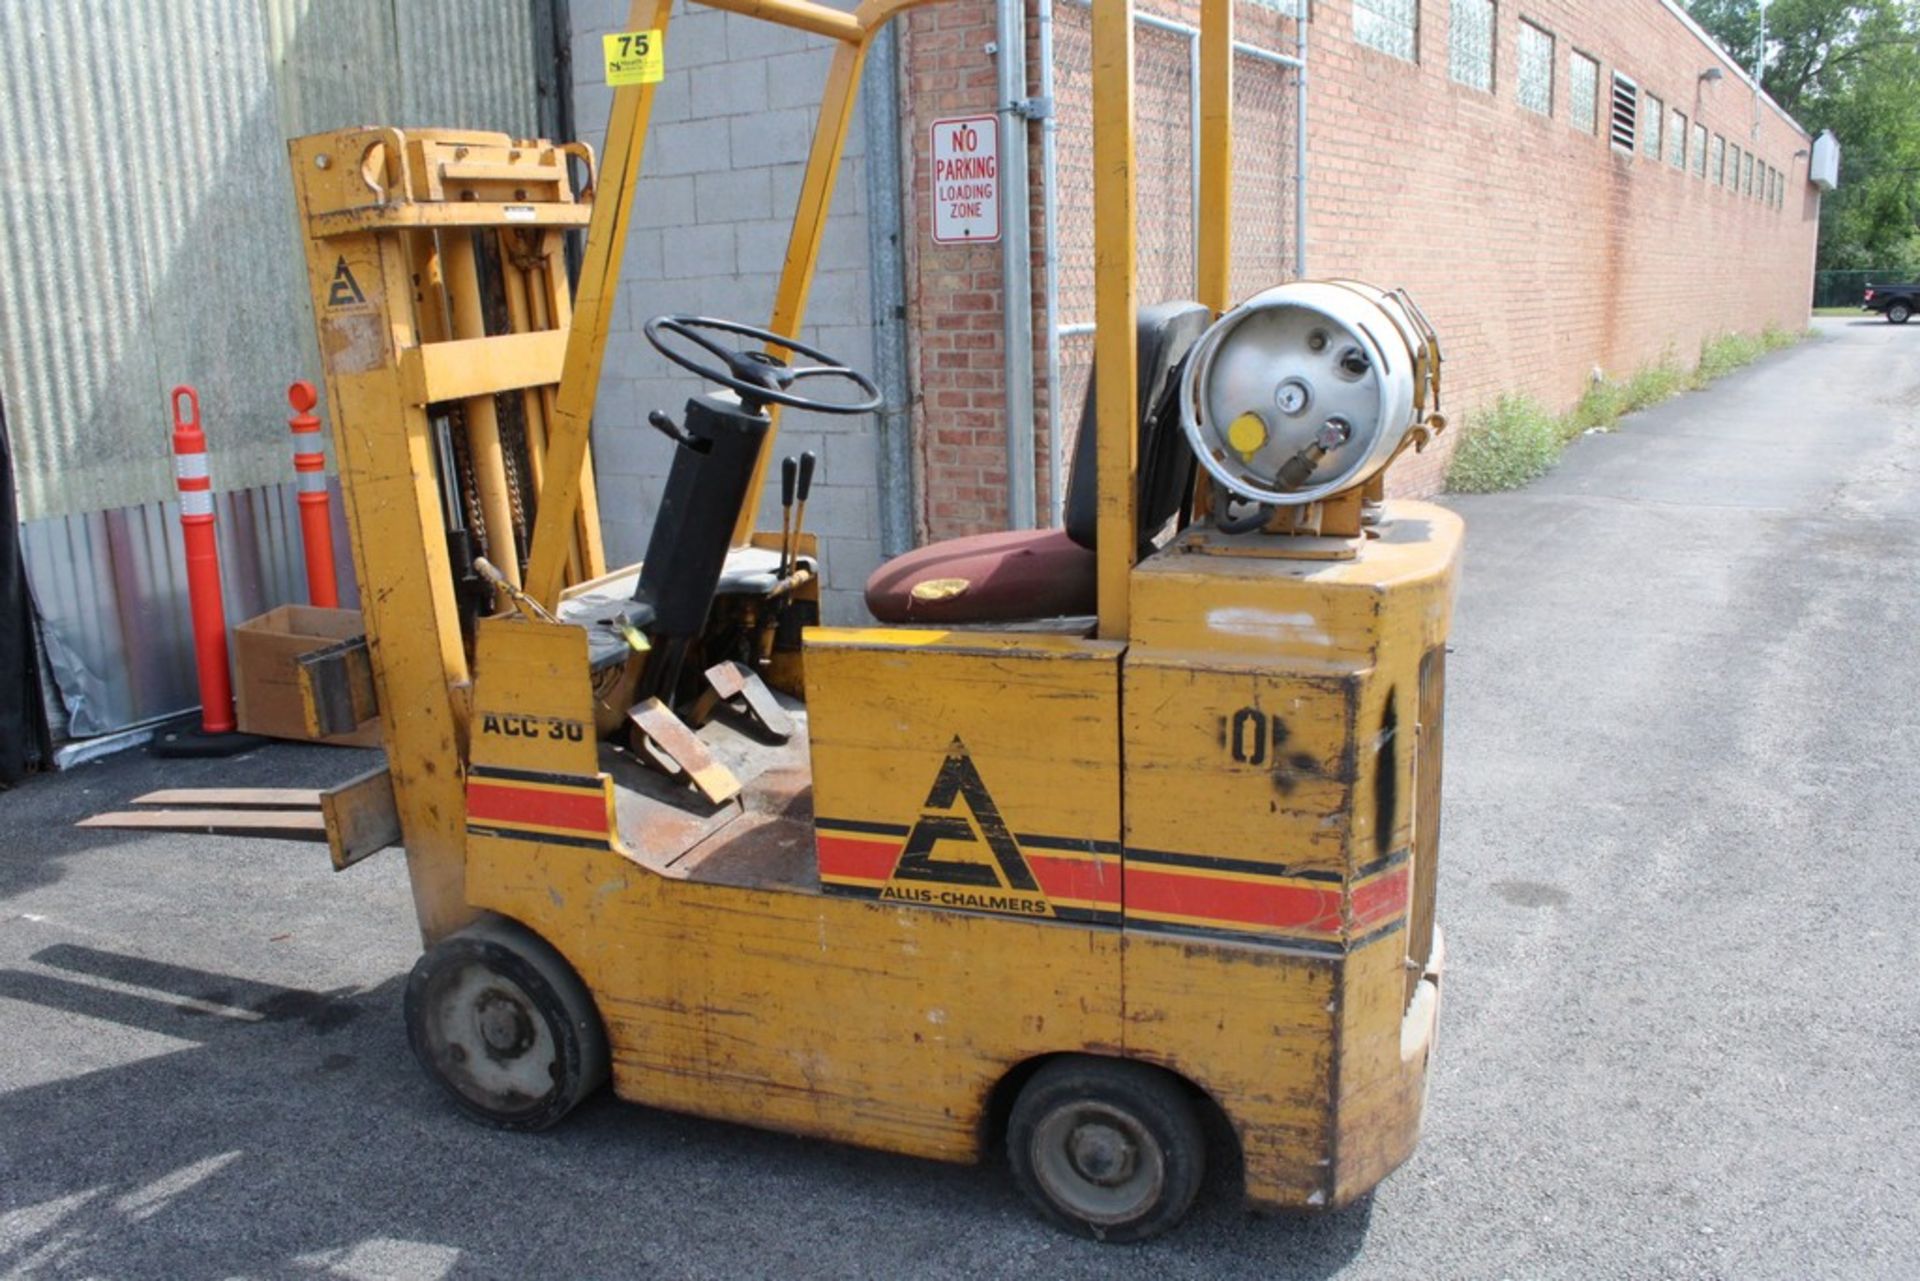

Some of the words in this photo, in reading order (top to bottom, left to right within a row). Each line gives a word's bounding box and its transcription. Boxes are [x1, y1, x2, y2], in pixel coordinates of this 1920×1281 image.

[617, 35, 649, 57] 75
[952, 129, 977, 152] NO
[936, 156, 995, 180] PARKING
[940, 184, 993, 201] LOADING
[950, 203, 982, 218] ZONE
[483, 713, 538, 738] ACC
[547, 716, 583, 742] 30
[883, 886, 1047, 913] ALLIS-CHALMERS
